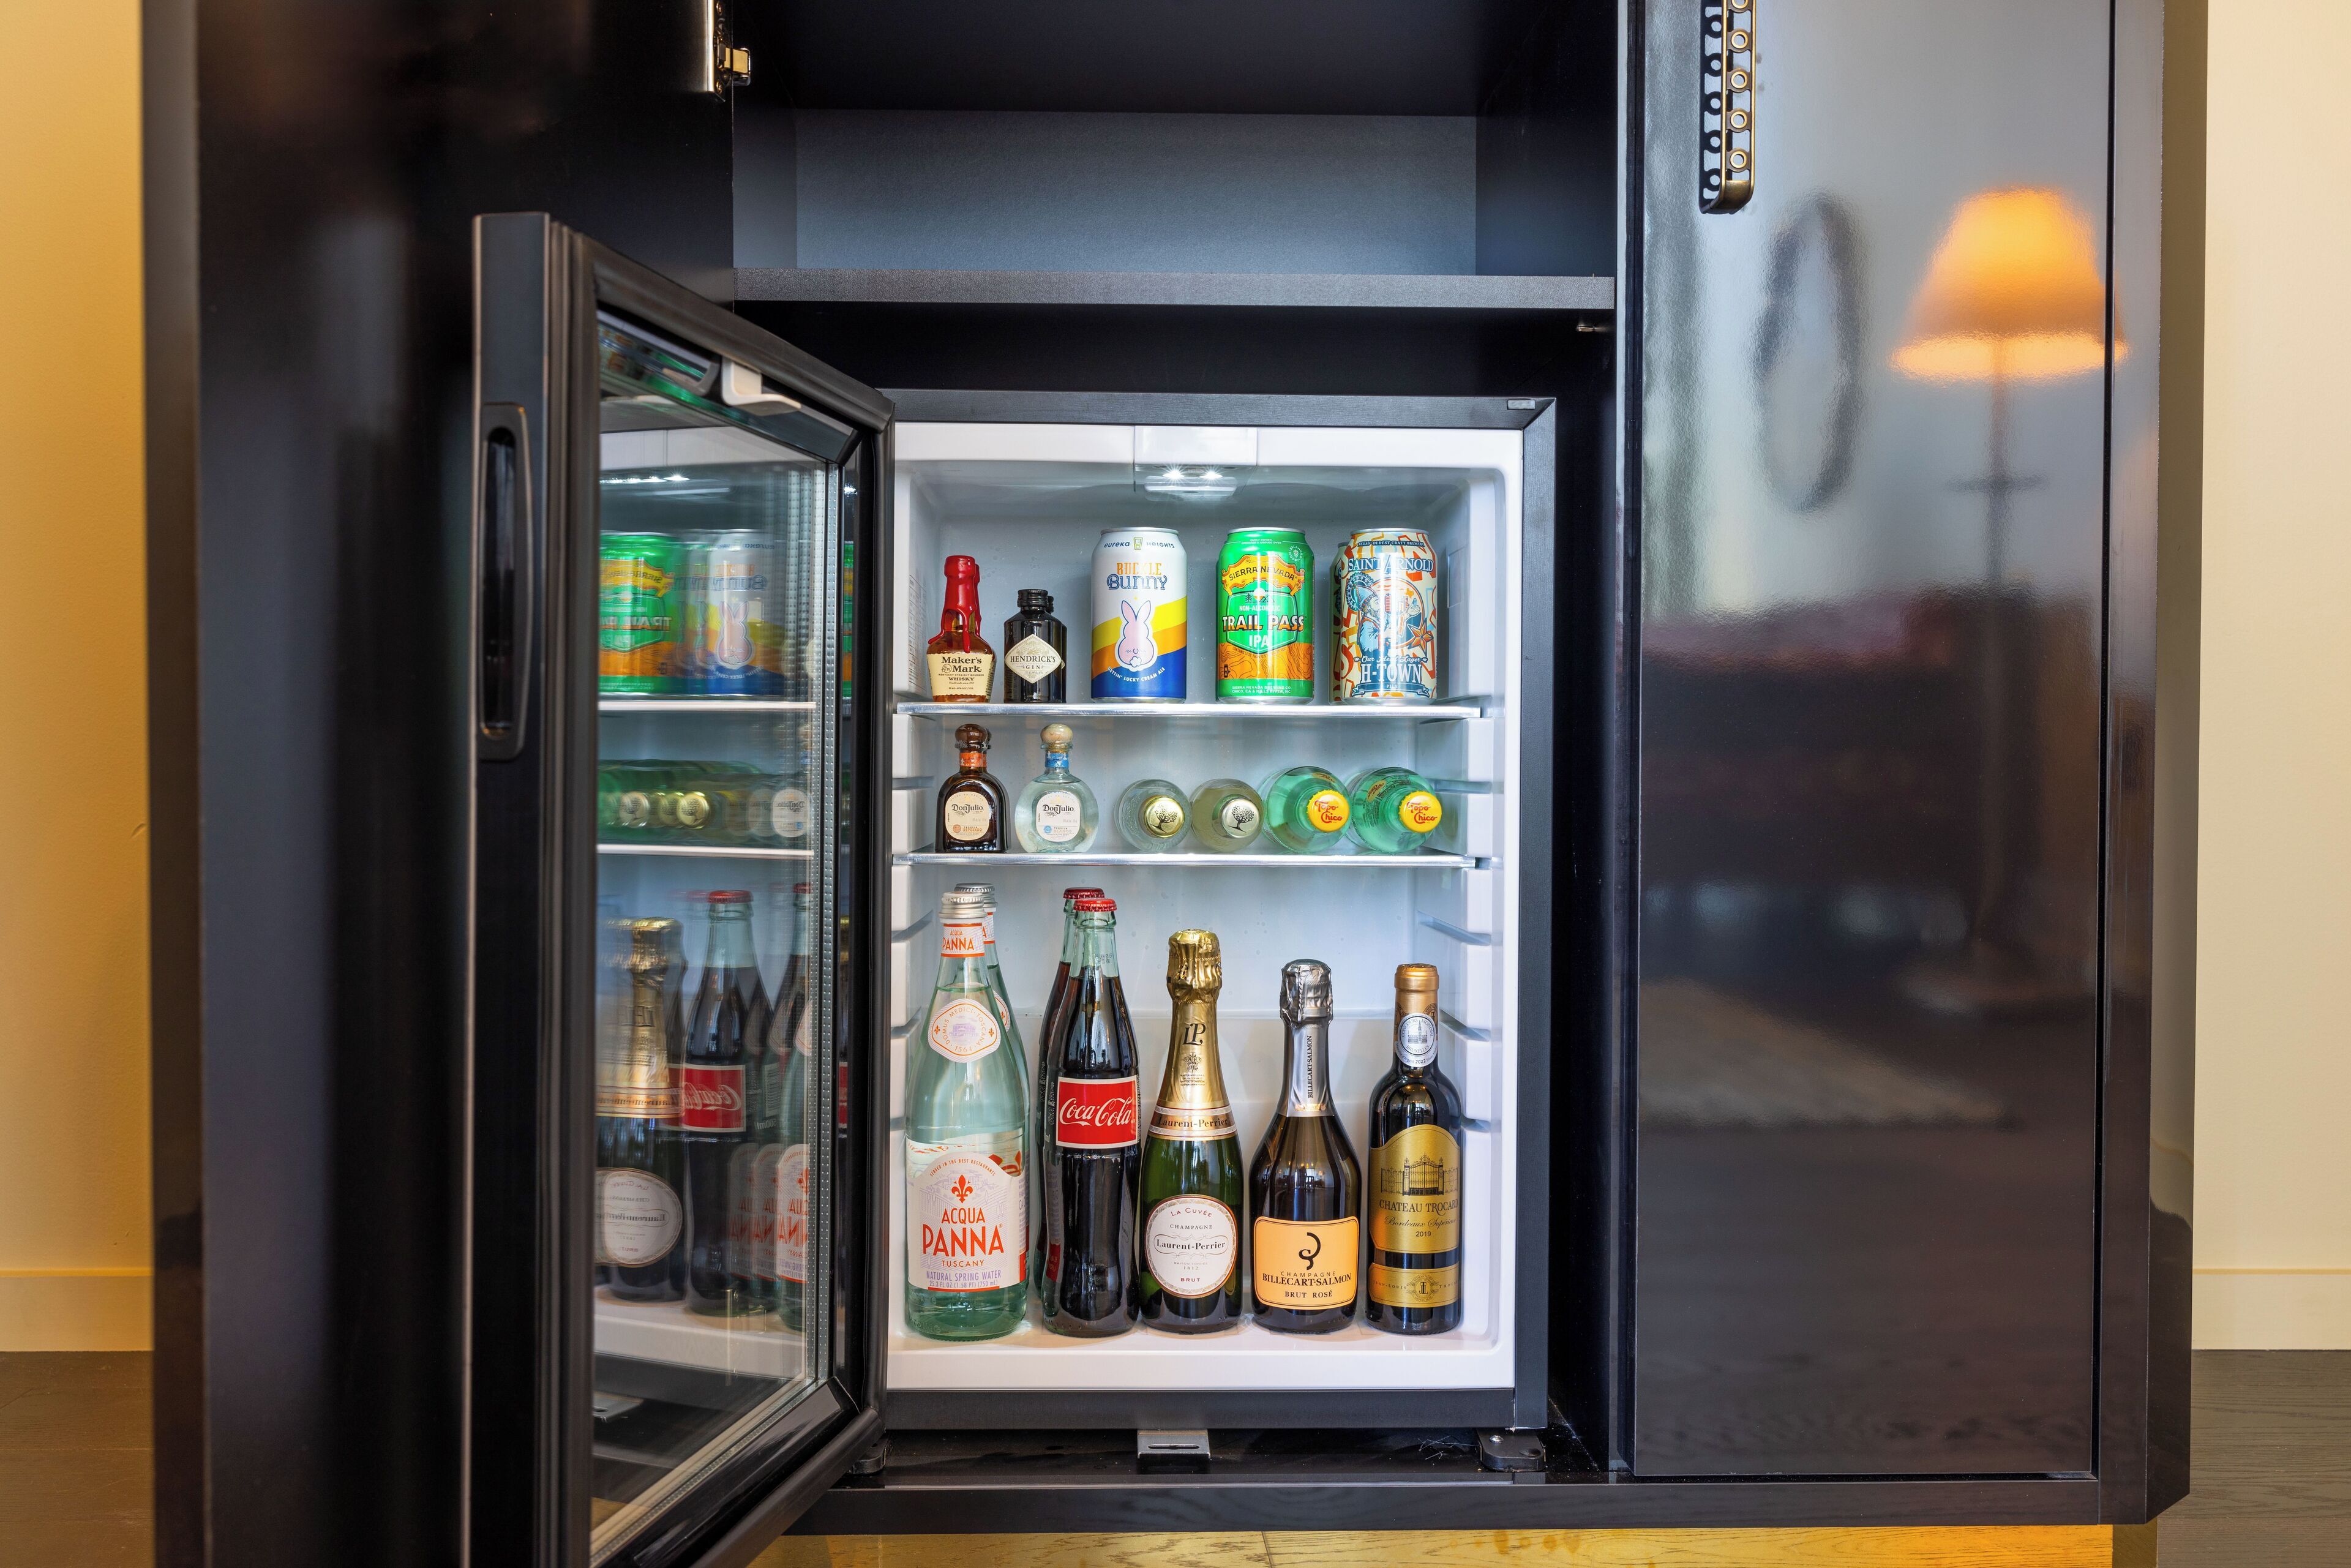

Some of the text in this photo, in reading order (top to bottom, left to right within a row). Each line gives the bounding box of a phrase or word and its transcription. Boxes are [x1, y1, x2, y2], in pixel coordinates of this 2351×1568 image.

[1117, 562, 1162, 575] BUCLE
[1348, 555, 1434, 574] SAINT ARNOLD
[1229, 567, 1258, 581] SIERRA
[1222, 615, 1304, 632] TRAIL PASS
[1249, 634, 1270, 648] IPA
[1141, 673, 1158, 681] CREAM
[1361, 664, 1422, 683] H-TOWN
[1314, 800, 1338, 813] Topo
[1407, 801, 1431, 814] Topo
[1321, 811, 1343, 823] Chico
[1414, 812, 1438, 824] Chico
[942, 937, 975, 951] PANNA
[950, 1007, 973, 1018] MEDICI
[1183, 1023, 1205, 1045] LP
[1401, 1019, 1433, 1038] CONCOURS MONDIAL
[1406, 1045, 1430, 1053] BRUXELLES
[1059, 1096, 1133, 1127] Coca-Cola
[1158, 1116, 1228, 1128] Laurent-Perrier
[930, 1165, 942, 1177] SERVED
[970, 1159, 996, 1176] RESTAURANTS
[1185, 1207, 1213, 1217] CUVÉE
[1379, 1199, 1458, 1216] CHATEAU TROCARD
[941, 1207, 986, 1225] ACQUA
[1384, 1216, 1425, 1227] Bordeaux
[923, 1224, 1004, 1257] PANNA
[1157, 1239, 1225, 1250] Laurent-Perrier
[926, 1270, 1001, 1281] NATURAL SPRING WATER
[1262, 1273, 1351, 1286] BILLECART-SALMON
